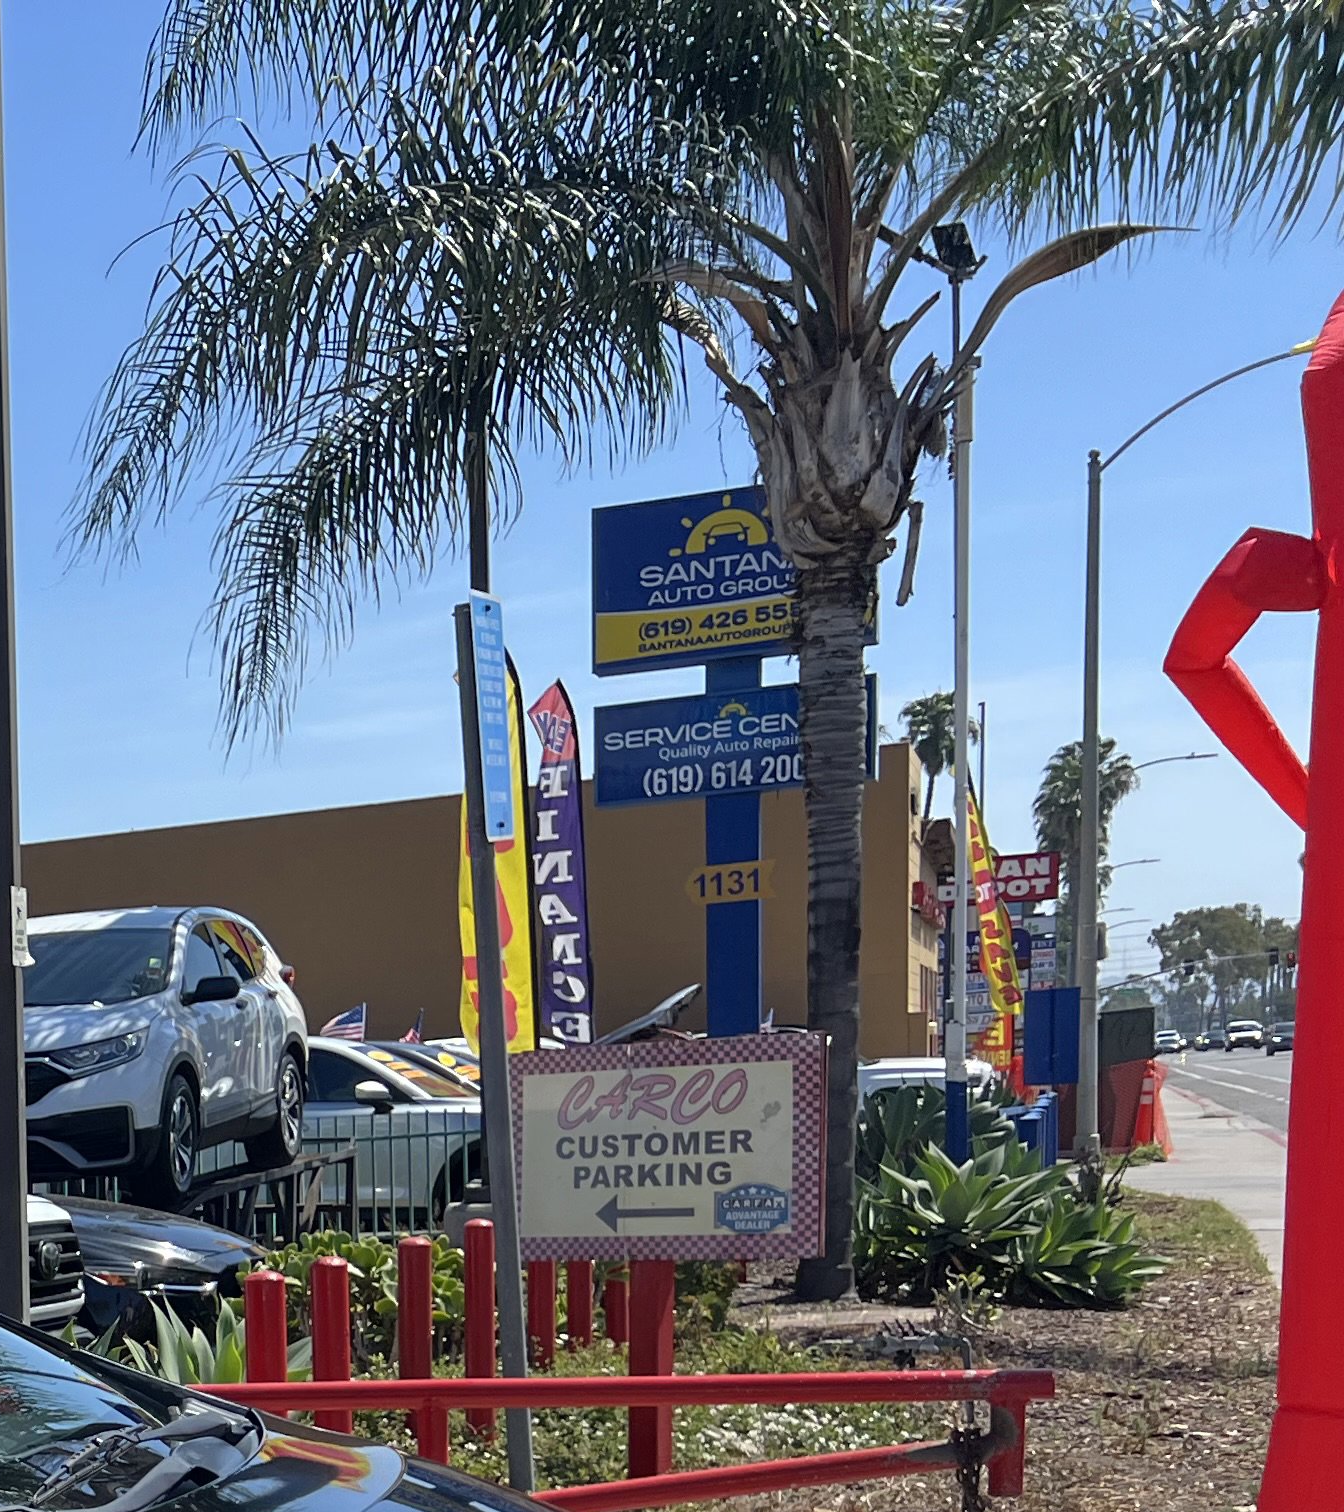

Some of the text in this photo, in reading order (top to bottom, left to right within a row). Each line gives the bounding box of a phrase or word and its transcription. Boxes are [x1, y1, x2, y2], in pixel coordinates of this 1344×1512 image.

[640, 550, 794, 588] SANTAN
[647, 573, 796, 607] AUTO GROU
[638, 602, 802, 642] (619) 426 555
[603, 712, 799, 751] SERVICE CEN
[658, 731, 799, 761] Quality Auto Repair
[642, 752, 806, 797] (619) 614 200
[693, 868, 760, 898] 1131
[557, 1068, 749, 1130] CARCO
[555, 1130, 754, 1160] CUSTOMER
[573, 1161, 732, 1189] PARKING
[721, 1196, 785, 1209] CARFAX
[725, 1209, 780, 1221] ADVANTAGE
[734, 1220, 771, 1231] DEALER
